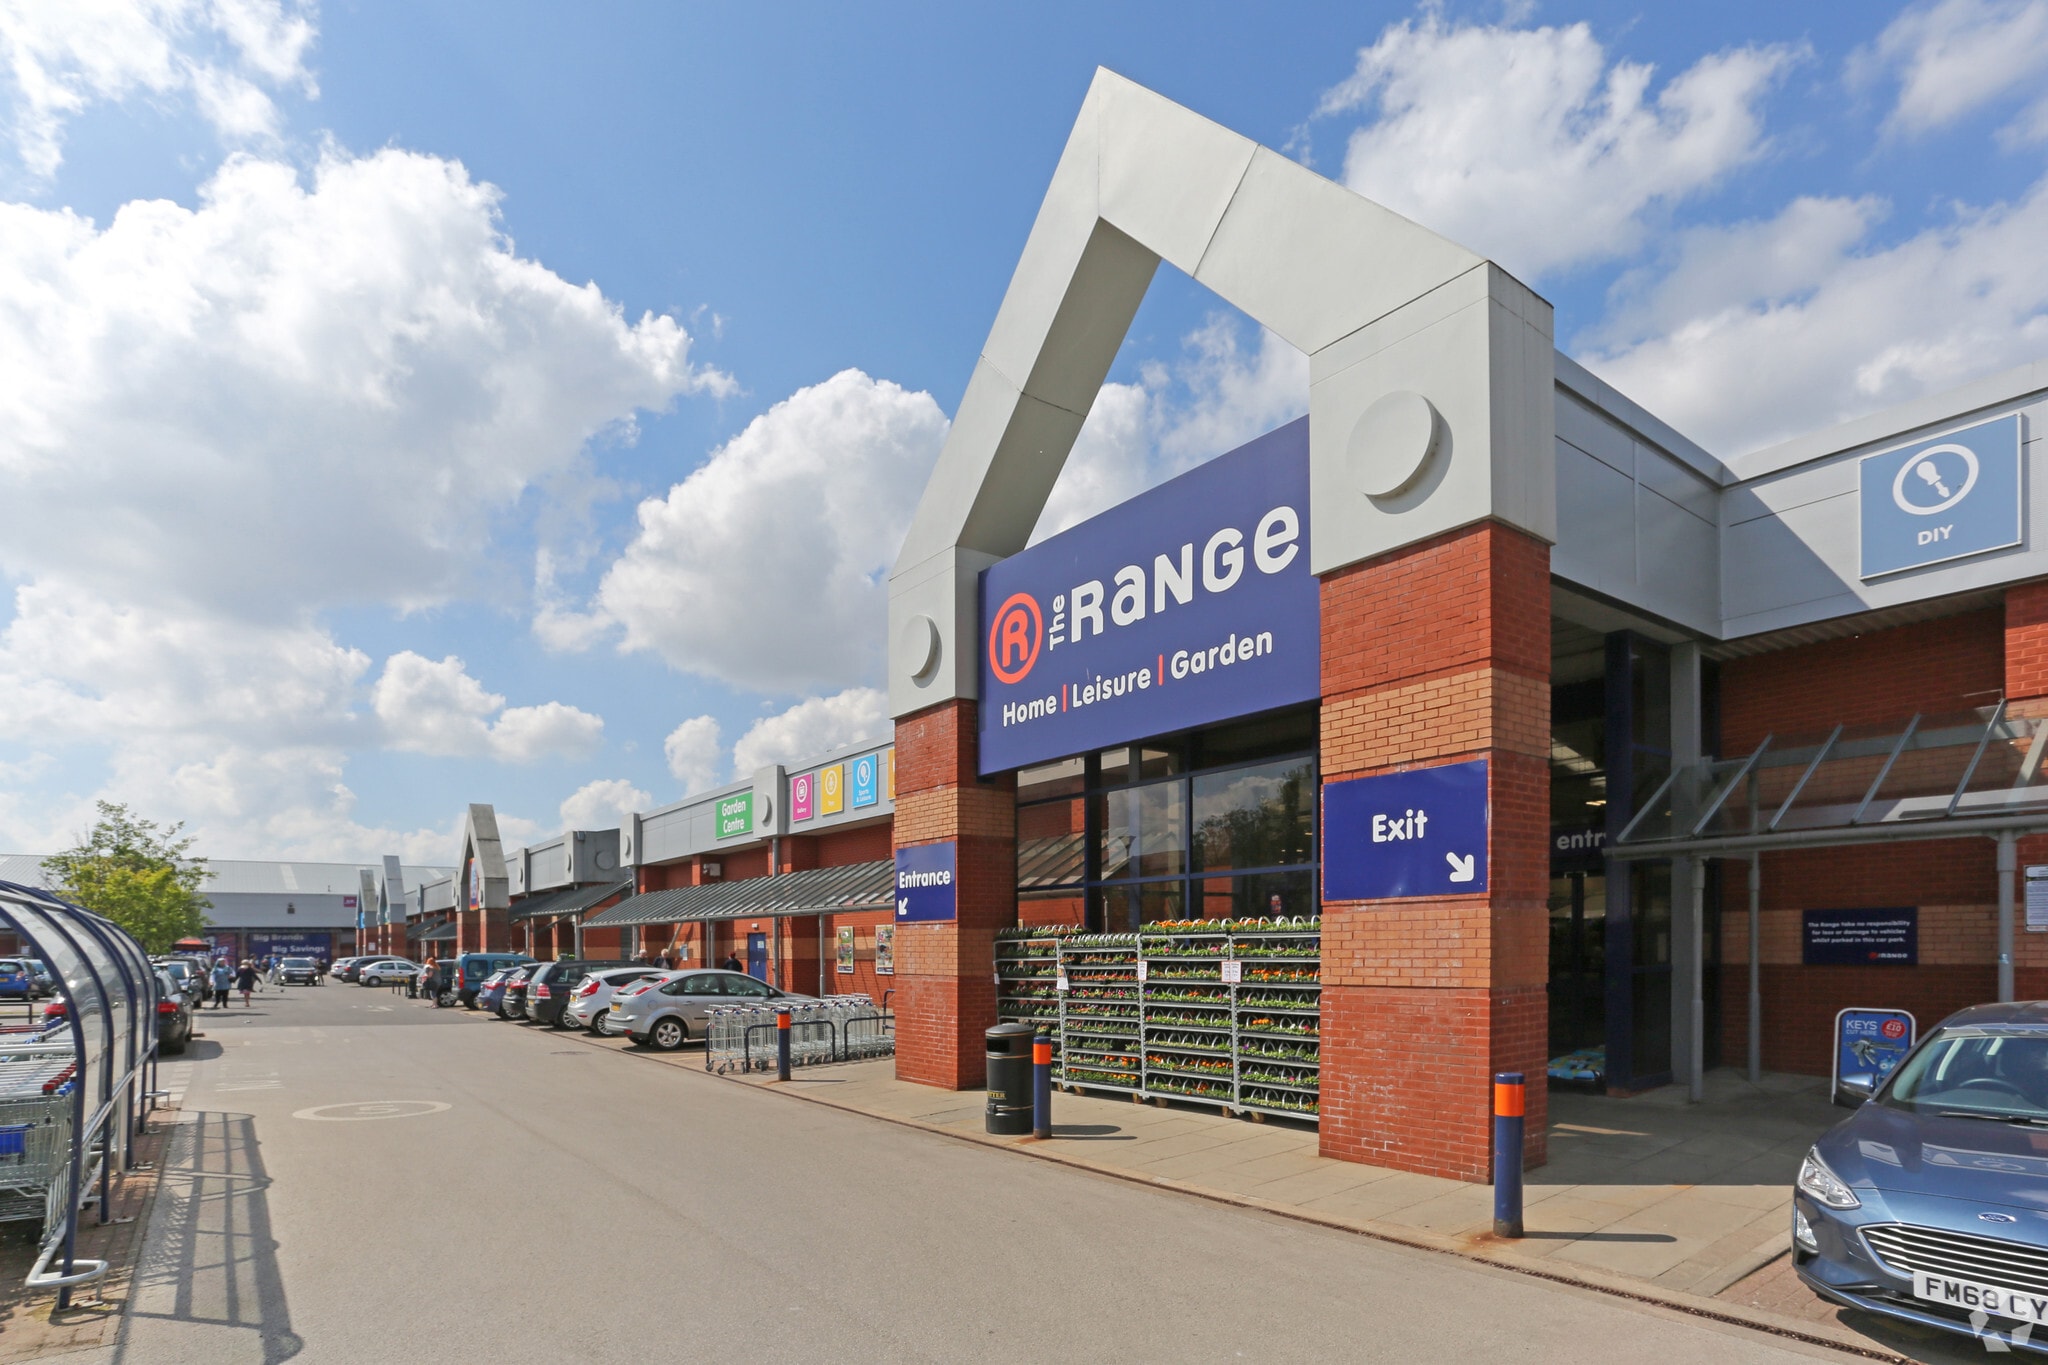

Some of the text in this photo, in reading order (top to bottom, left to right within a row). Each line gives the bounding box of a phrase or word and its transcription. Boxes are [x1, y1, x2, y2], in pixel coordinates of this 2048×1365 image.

[1917, 523, 1954, 546] DIY
[1049, 594, 1065, 652] The
[1002, 630, 1273, 727] Home Leisure Garden
[721, 798, 746, 817] Garden
[723, 817, 745, 834] Centre
[1372, 808, 1428, 843] Exit
[1556, 829, 1607, 850] entr
[898, 869, 951, 890] Entrance
[253, 933, 304, 942] Big Brands
[271, 945, 326, 954] Big Savings
[1846, 1020, 1877, 1030] KEYS
[1886, 1023, 1902, 1032] £10
[1926, 1277, 1999, 1310] FM68
